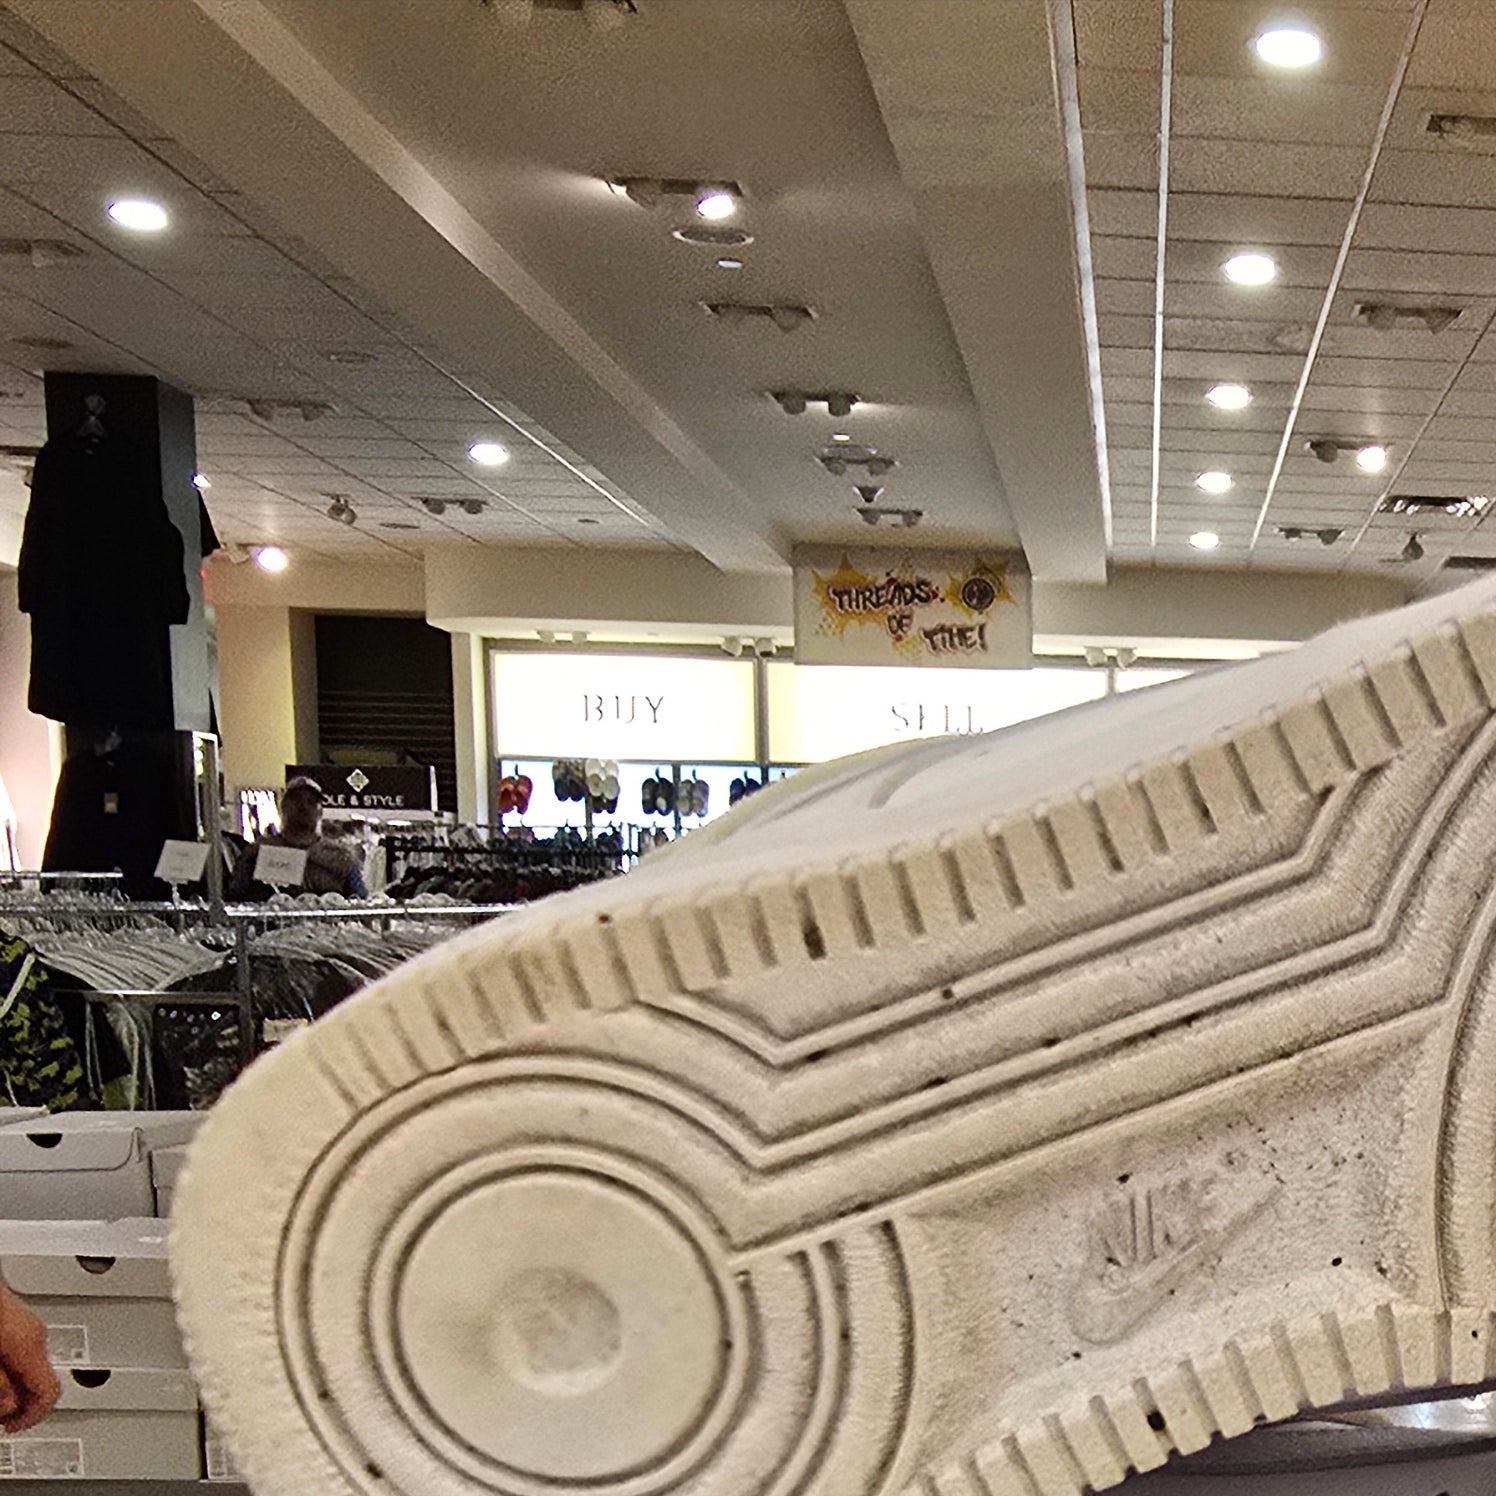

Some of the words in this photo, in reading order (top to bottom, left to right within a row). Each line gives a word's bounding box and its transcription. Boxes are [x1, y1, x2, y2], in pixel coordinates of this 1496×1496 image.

[829, 578, 932, 612] THREADS
[885, 612, 913, 636] OF
[583, 694, 664, 723] BUY
[891, 703, 983, 737] SELL
[350, 794, 359, 806] &
[364, 794, 404, 807] STYLE
